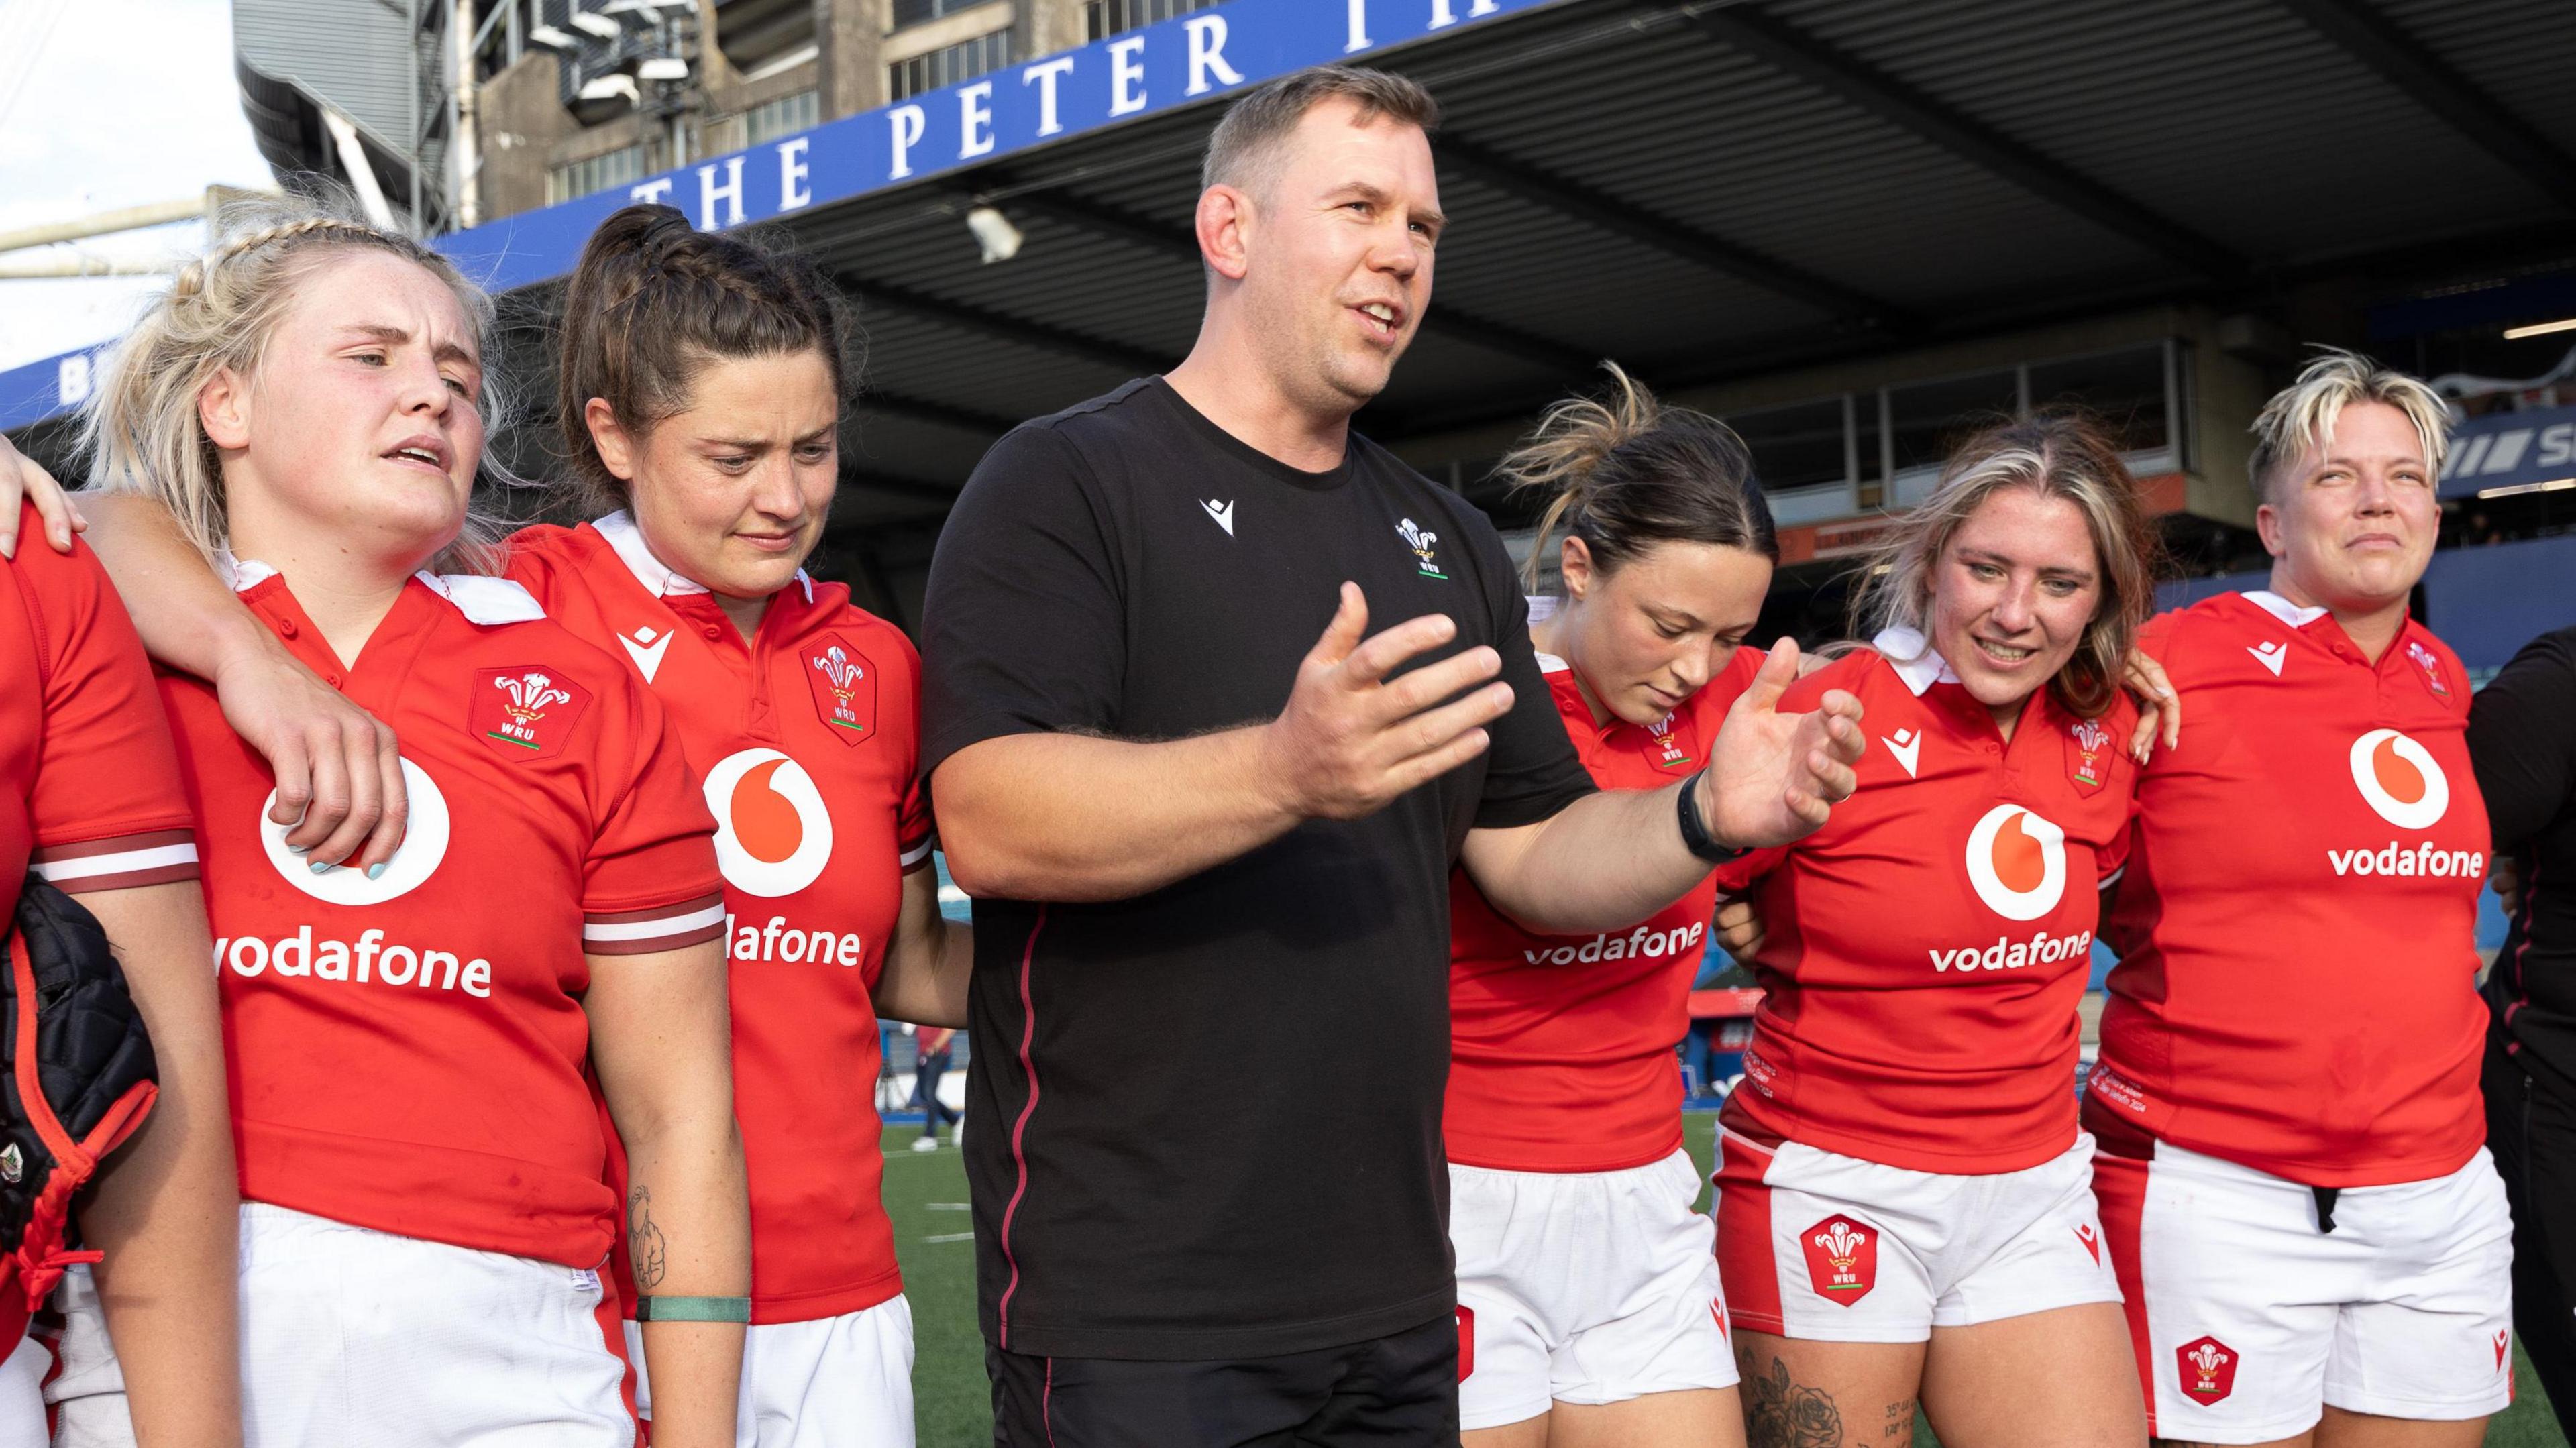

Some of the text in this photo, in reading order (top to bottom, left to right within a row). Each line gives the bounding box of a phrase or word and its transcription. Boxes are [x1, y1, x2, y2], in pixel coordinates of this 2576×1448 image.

[885, 14, 1246, 181] PETER
[835, 706, 856, 722] WRU
[501, 722, 535, 741] WRU
[1662, 748, 1683, 761] WRU
[2327, 840, 2483, 879] vodafone
[1523, 921, 1703, 965] vodafone
[1928, 930, 2091, 972] vodafone
[1833, 1273, 1856, 1284] WRU
